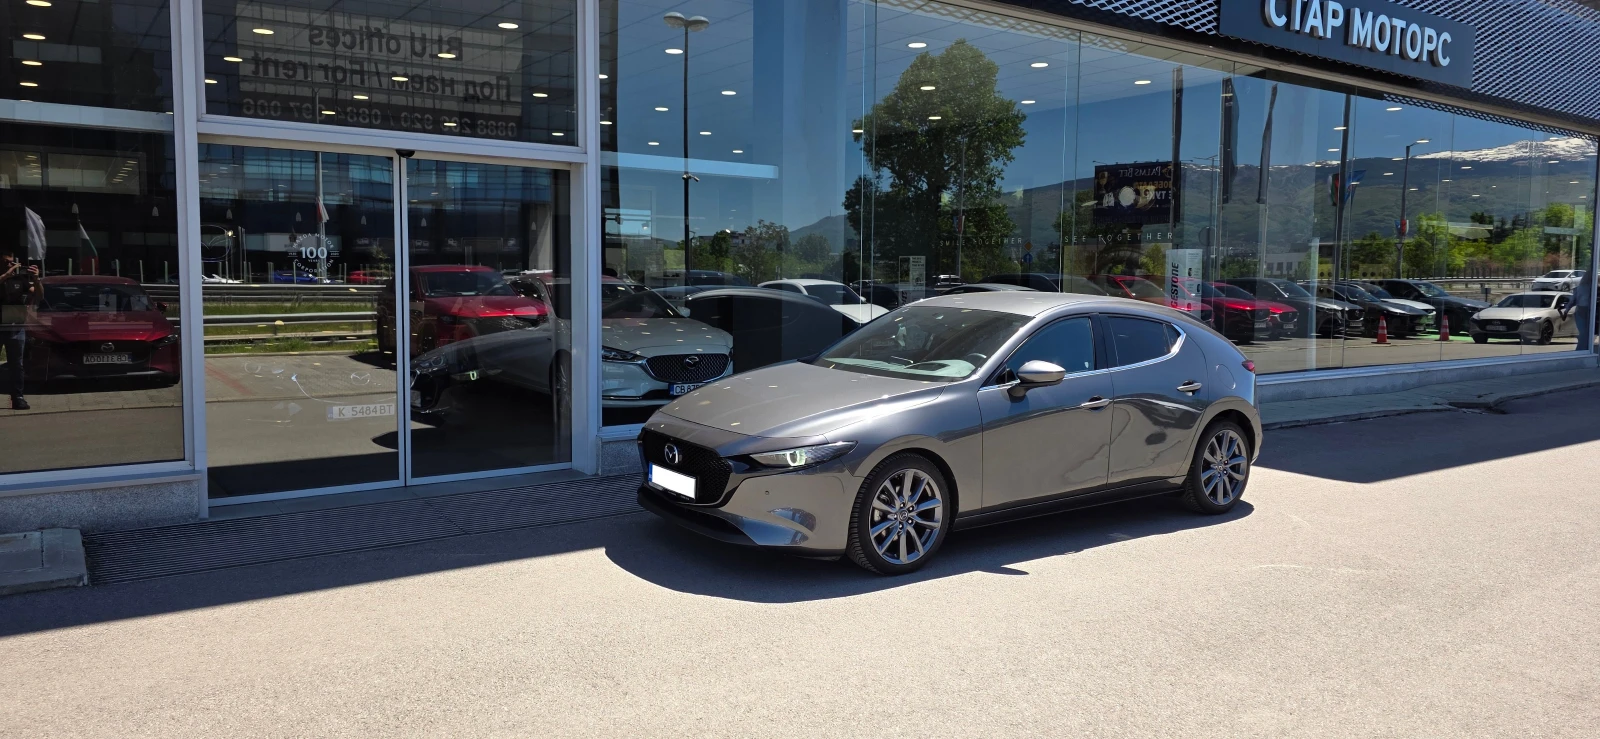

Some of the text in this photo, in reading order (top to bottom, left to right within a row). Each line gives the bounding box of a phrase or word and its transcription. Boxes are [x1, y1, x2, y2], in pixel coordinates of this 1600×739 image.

[1265, 0, 1452, 67] СТАР МОТОРС
[293, 233, 312, 248] MAZDA
[1098, 232, 1173, 242] TOGETHER
[300, 247, 327, 259] 100
